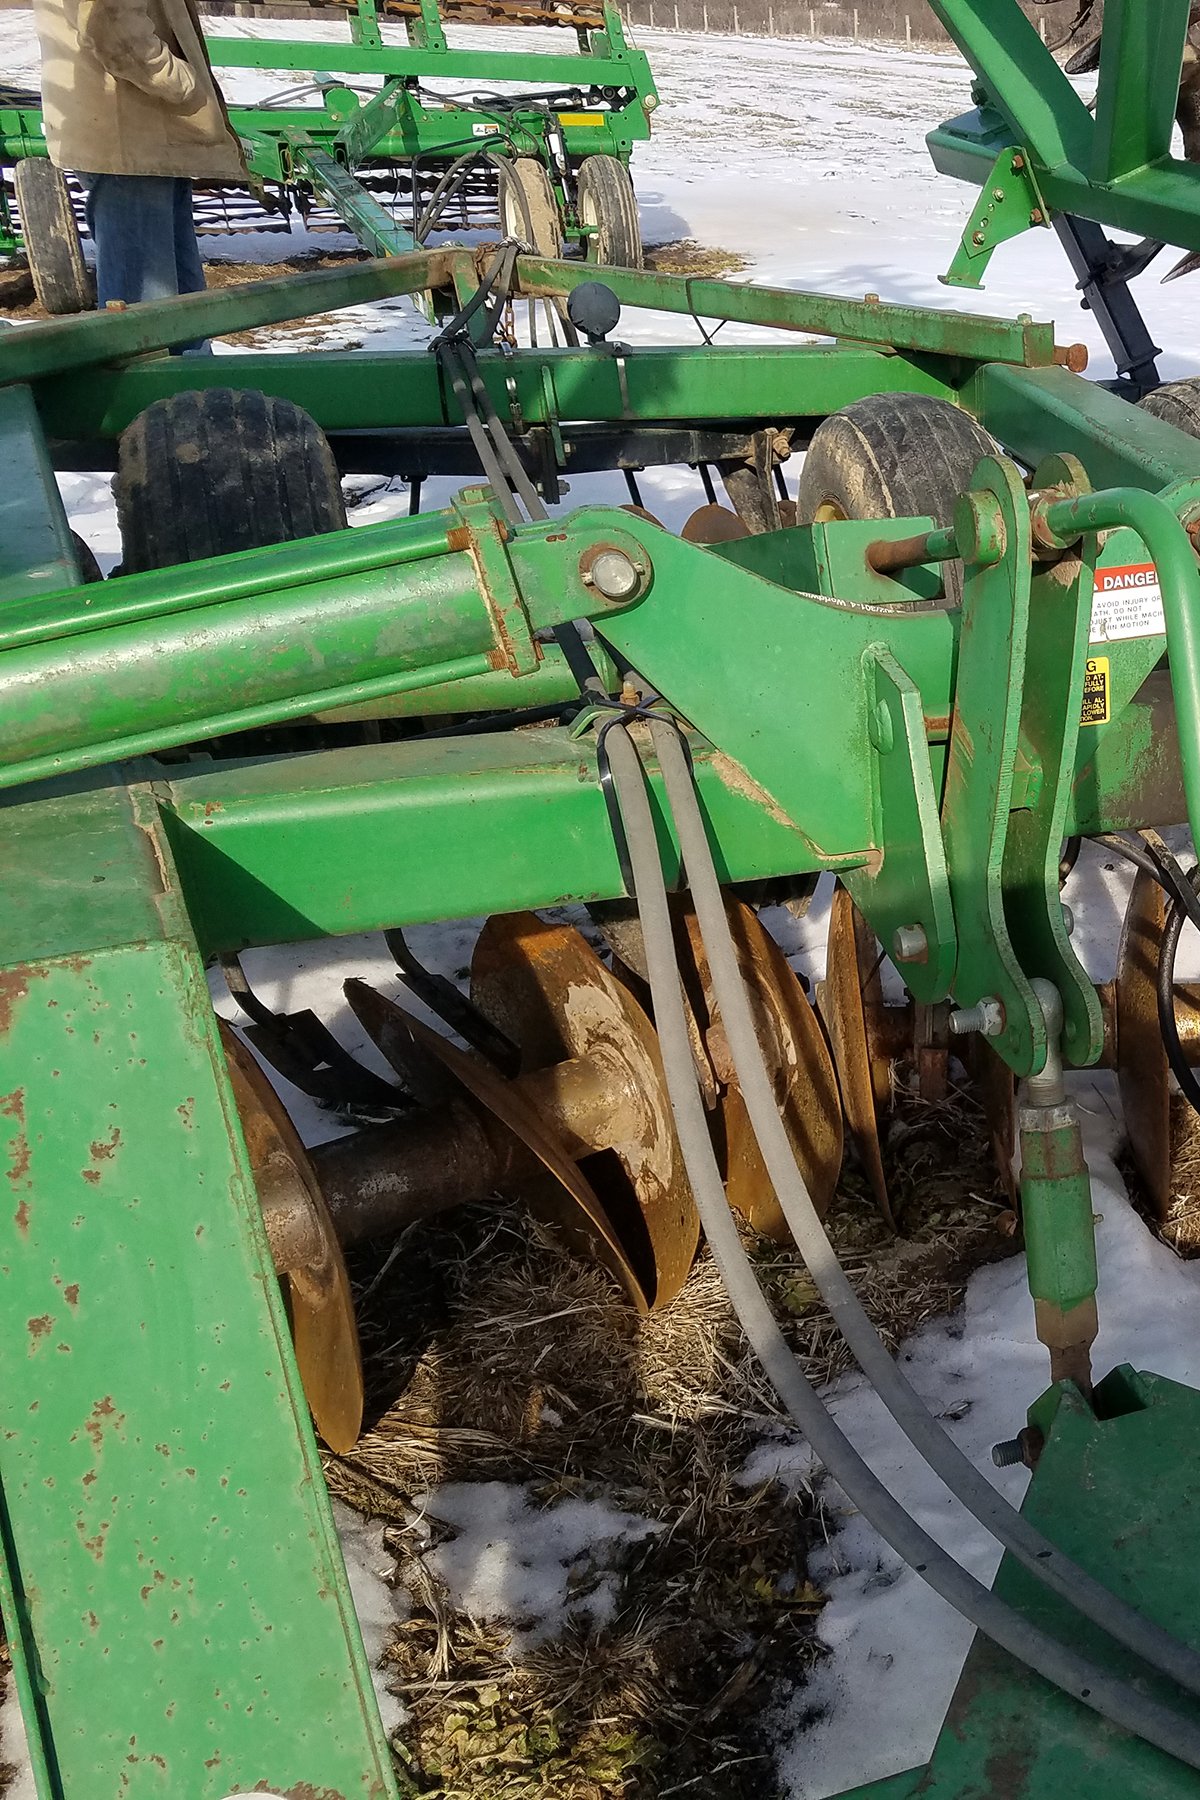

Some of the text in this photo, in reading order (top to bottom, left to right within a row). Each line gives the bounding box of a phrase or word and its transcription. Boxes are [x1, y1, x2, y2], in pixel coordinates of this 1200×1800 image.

[1097, 600, 1119, 608] AVOID
[1123, 597, 1148, 605] INJURY
[1120, 620, 1149, 628] MOTION
[1084, 685, 1104, 693] EFORE
